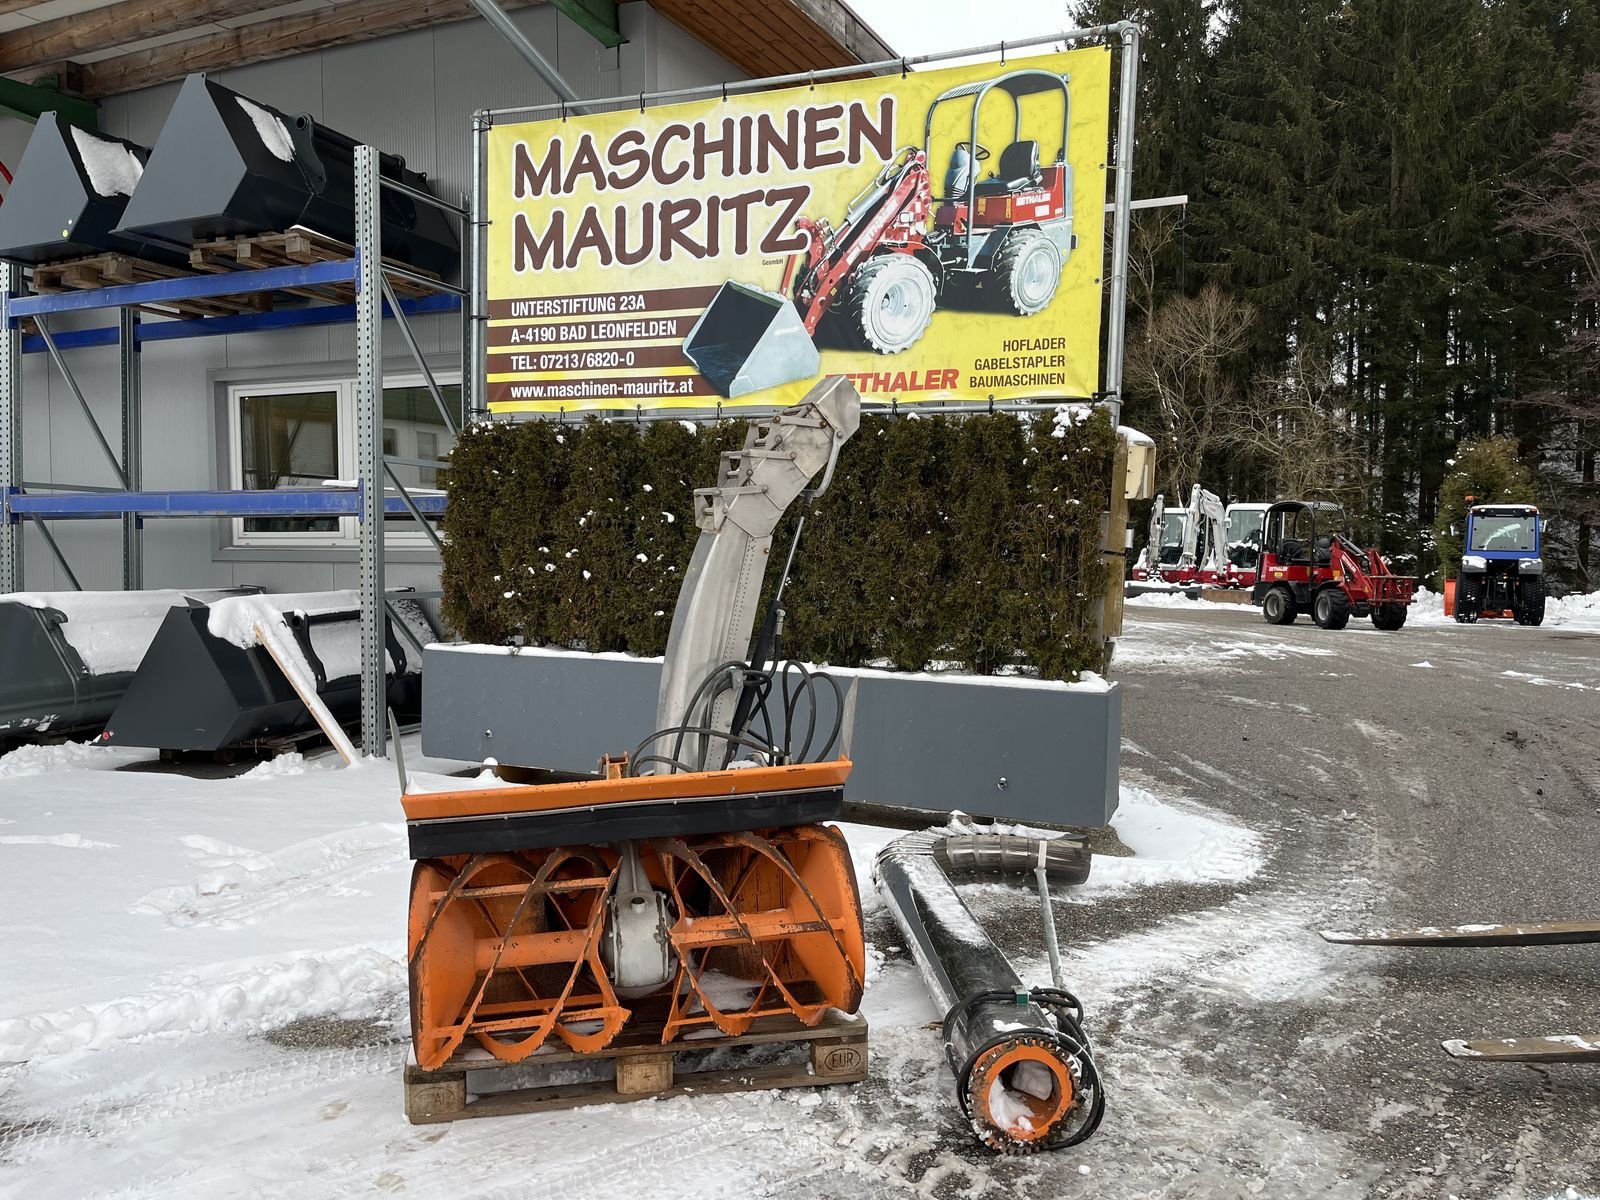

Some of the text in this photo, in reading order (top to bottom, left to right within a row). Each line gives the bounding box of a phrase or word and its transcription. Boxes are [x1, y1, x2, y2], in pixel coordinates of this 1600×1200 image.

[515, 98, 893, 198] MASCHINEN
[514, 185, 811, 272] MAURITZ
[511, 295, 646, 317] UNTERSTIFTUNG 23A
[510, 320, 677, 343] A-4190 BAD LEONFELDEN
[1003, 337, 1066, 352] HOFLADER
[511, 351, 635, 370] TEL: 07213/6820-0
[974, 355, 1066, 371] GABELSTAPLER
[511, 378, 694, 398] www.maschinen-mauritz.at
[969, 372, 1065, 388] BAUMASCHINEN
[832, 1051, 854, 1069] EUR
